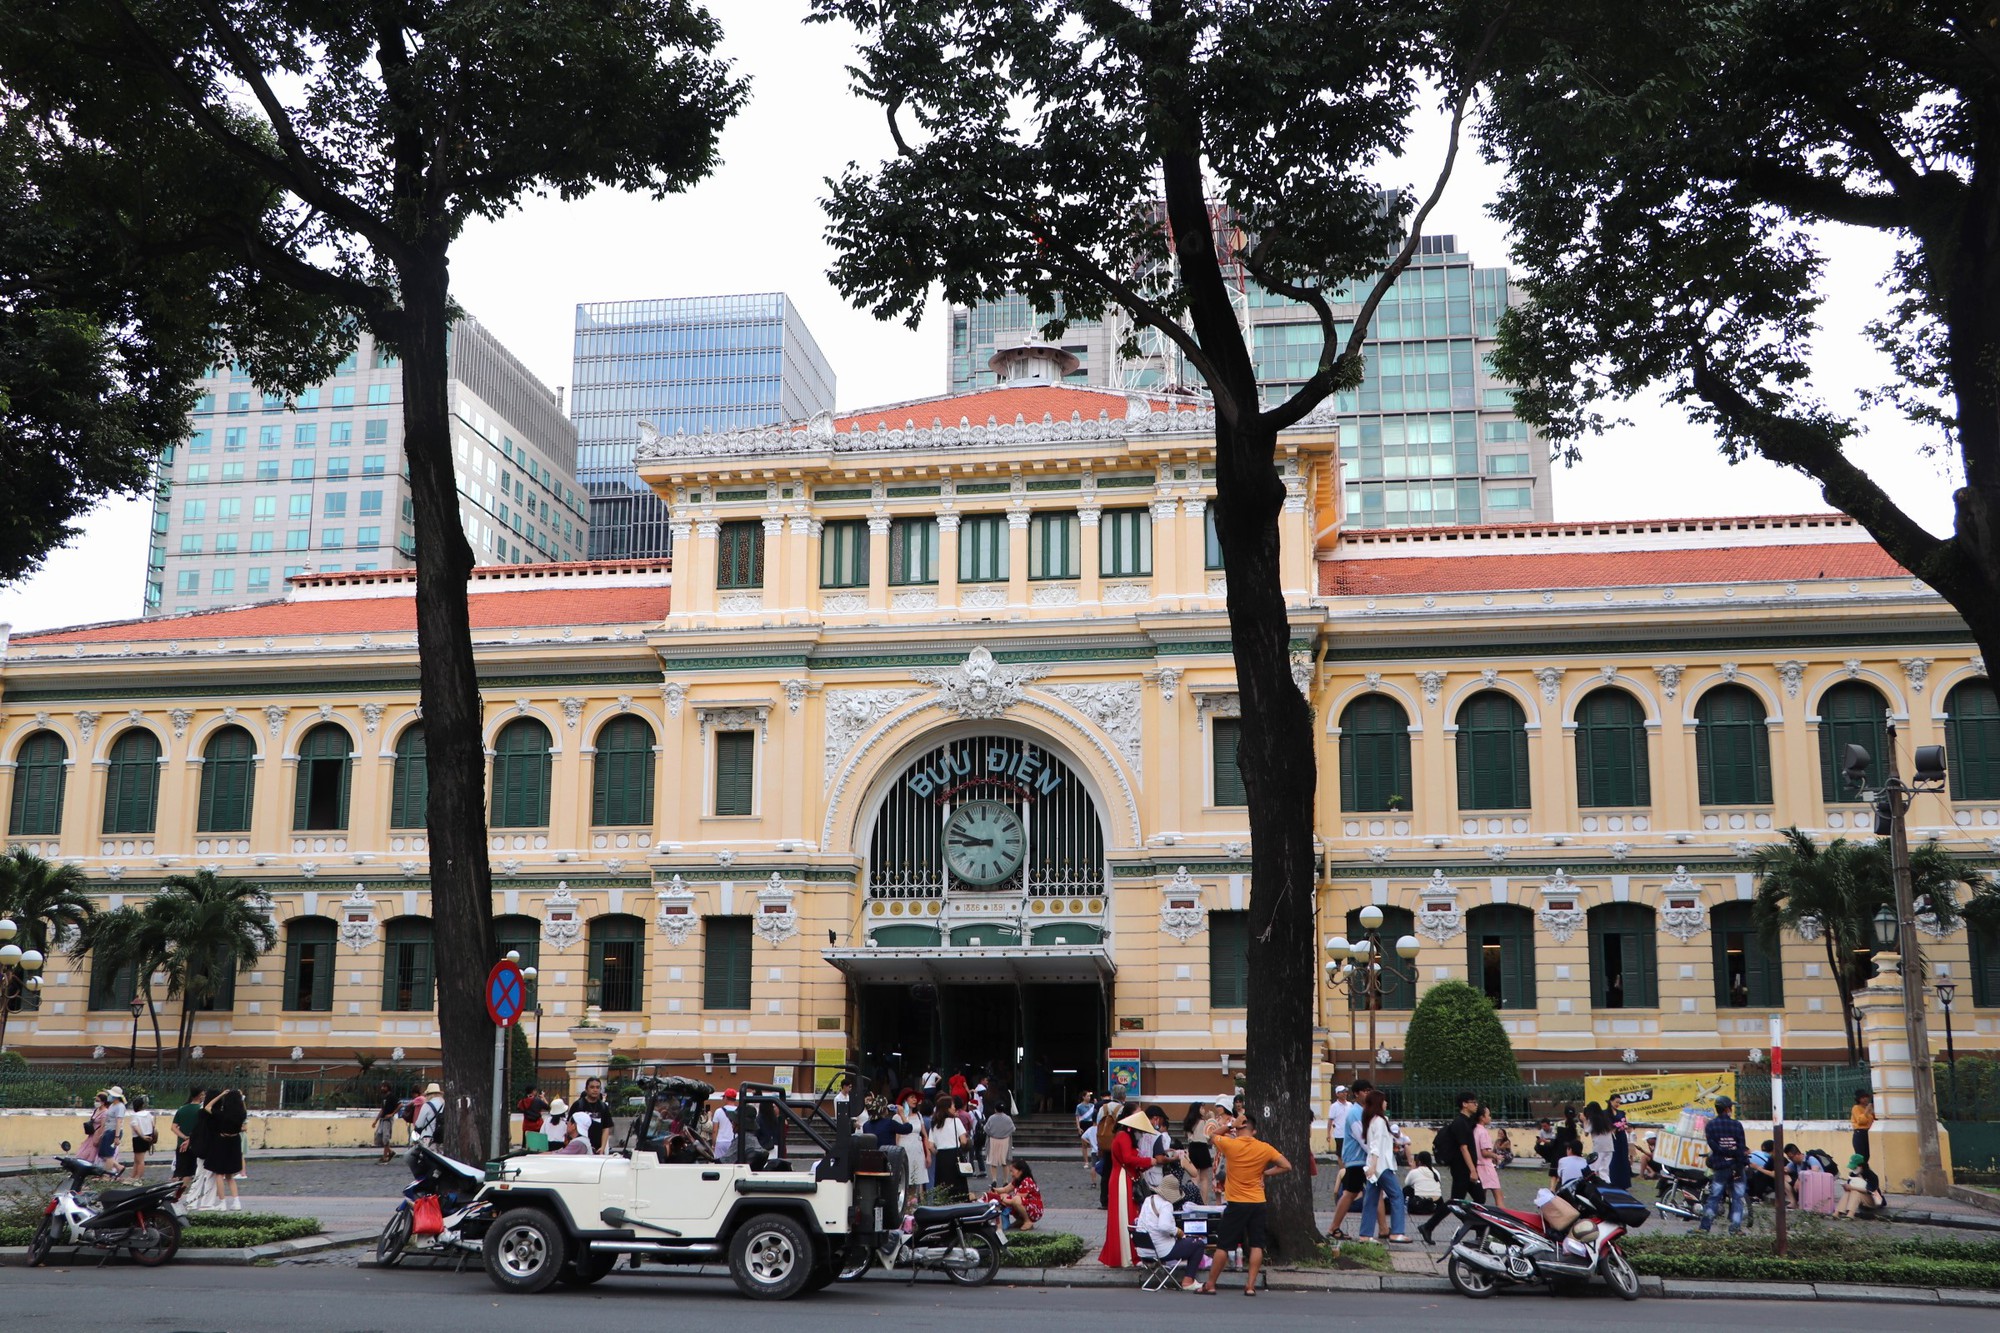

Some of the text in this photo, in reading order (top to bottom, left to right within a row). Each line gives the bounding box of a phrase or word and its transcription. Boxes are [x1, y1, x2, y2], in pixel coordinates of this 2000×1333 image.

[908, 748, 1062, 798] BƯU ĐIỆN
[964, 903, 1005, 911] 1886 1891
[1263, 1105, 1271, 1118] 8
[1657, 1131, 1679, 1161] KEM
